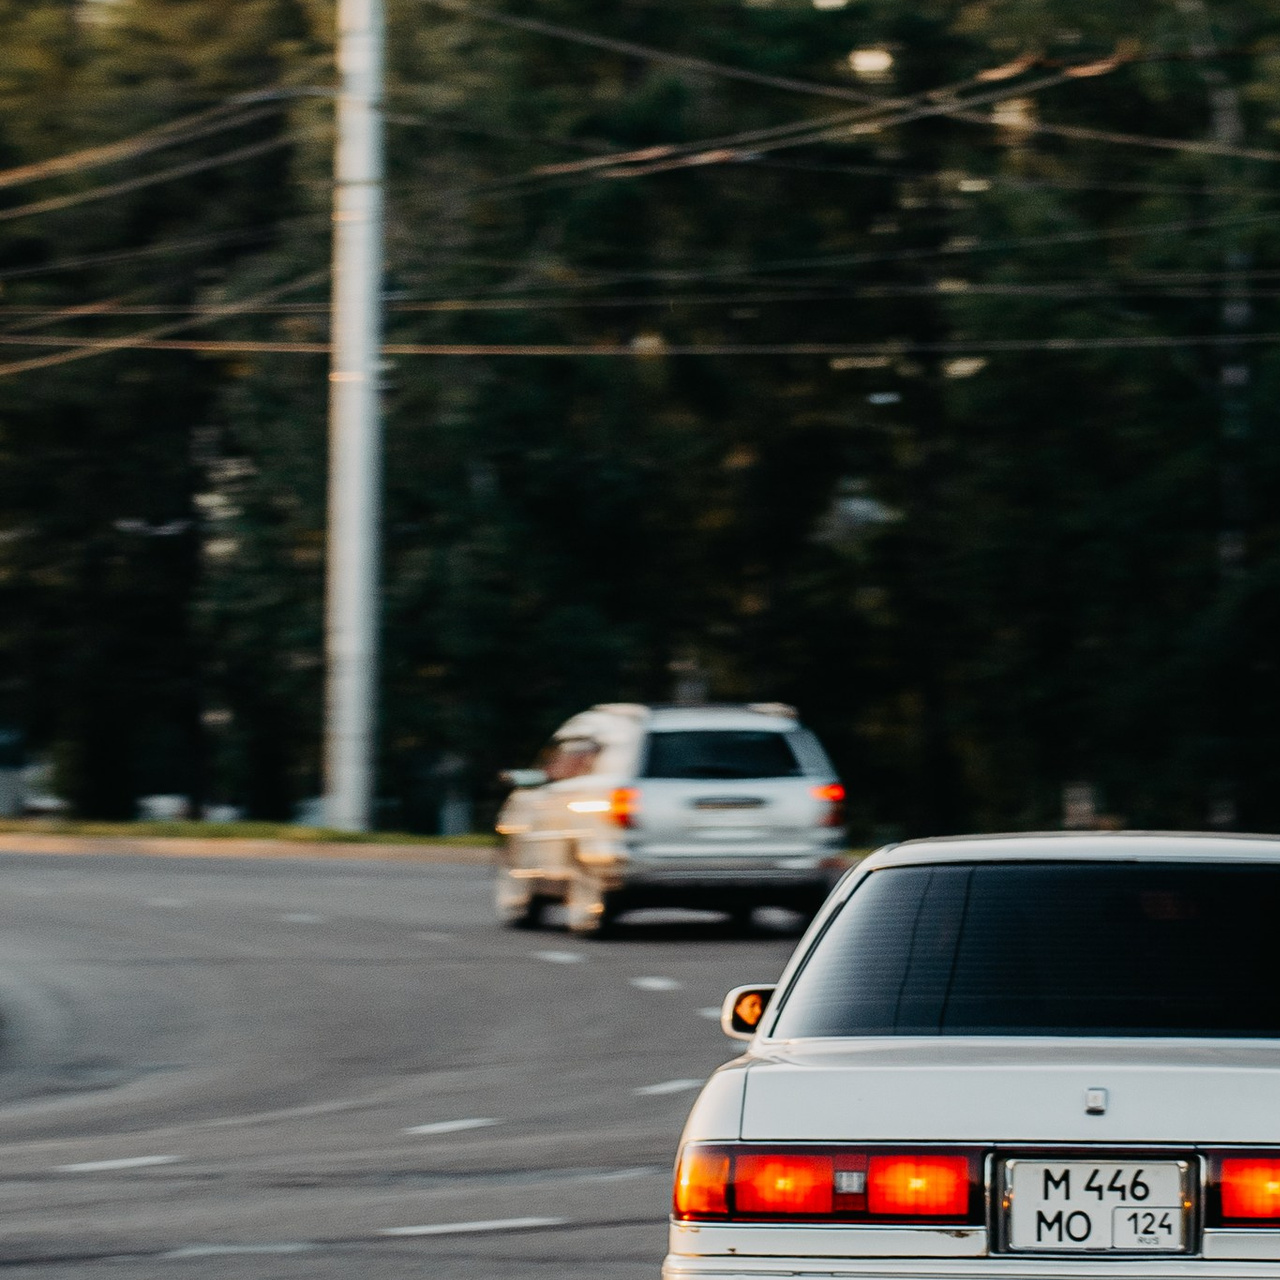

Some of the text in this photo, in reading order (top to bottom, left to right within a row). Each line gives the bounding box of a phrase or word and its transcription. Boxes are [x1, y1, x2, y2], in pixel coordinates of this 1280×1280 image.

[1036, 1209, 1173, 1242] MO 124
[1136, 1236, 1160, 1245] RUS
